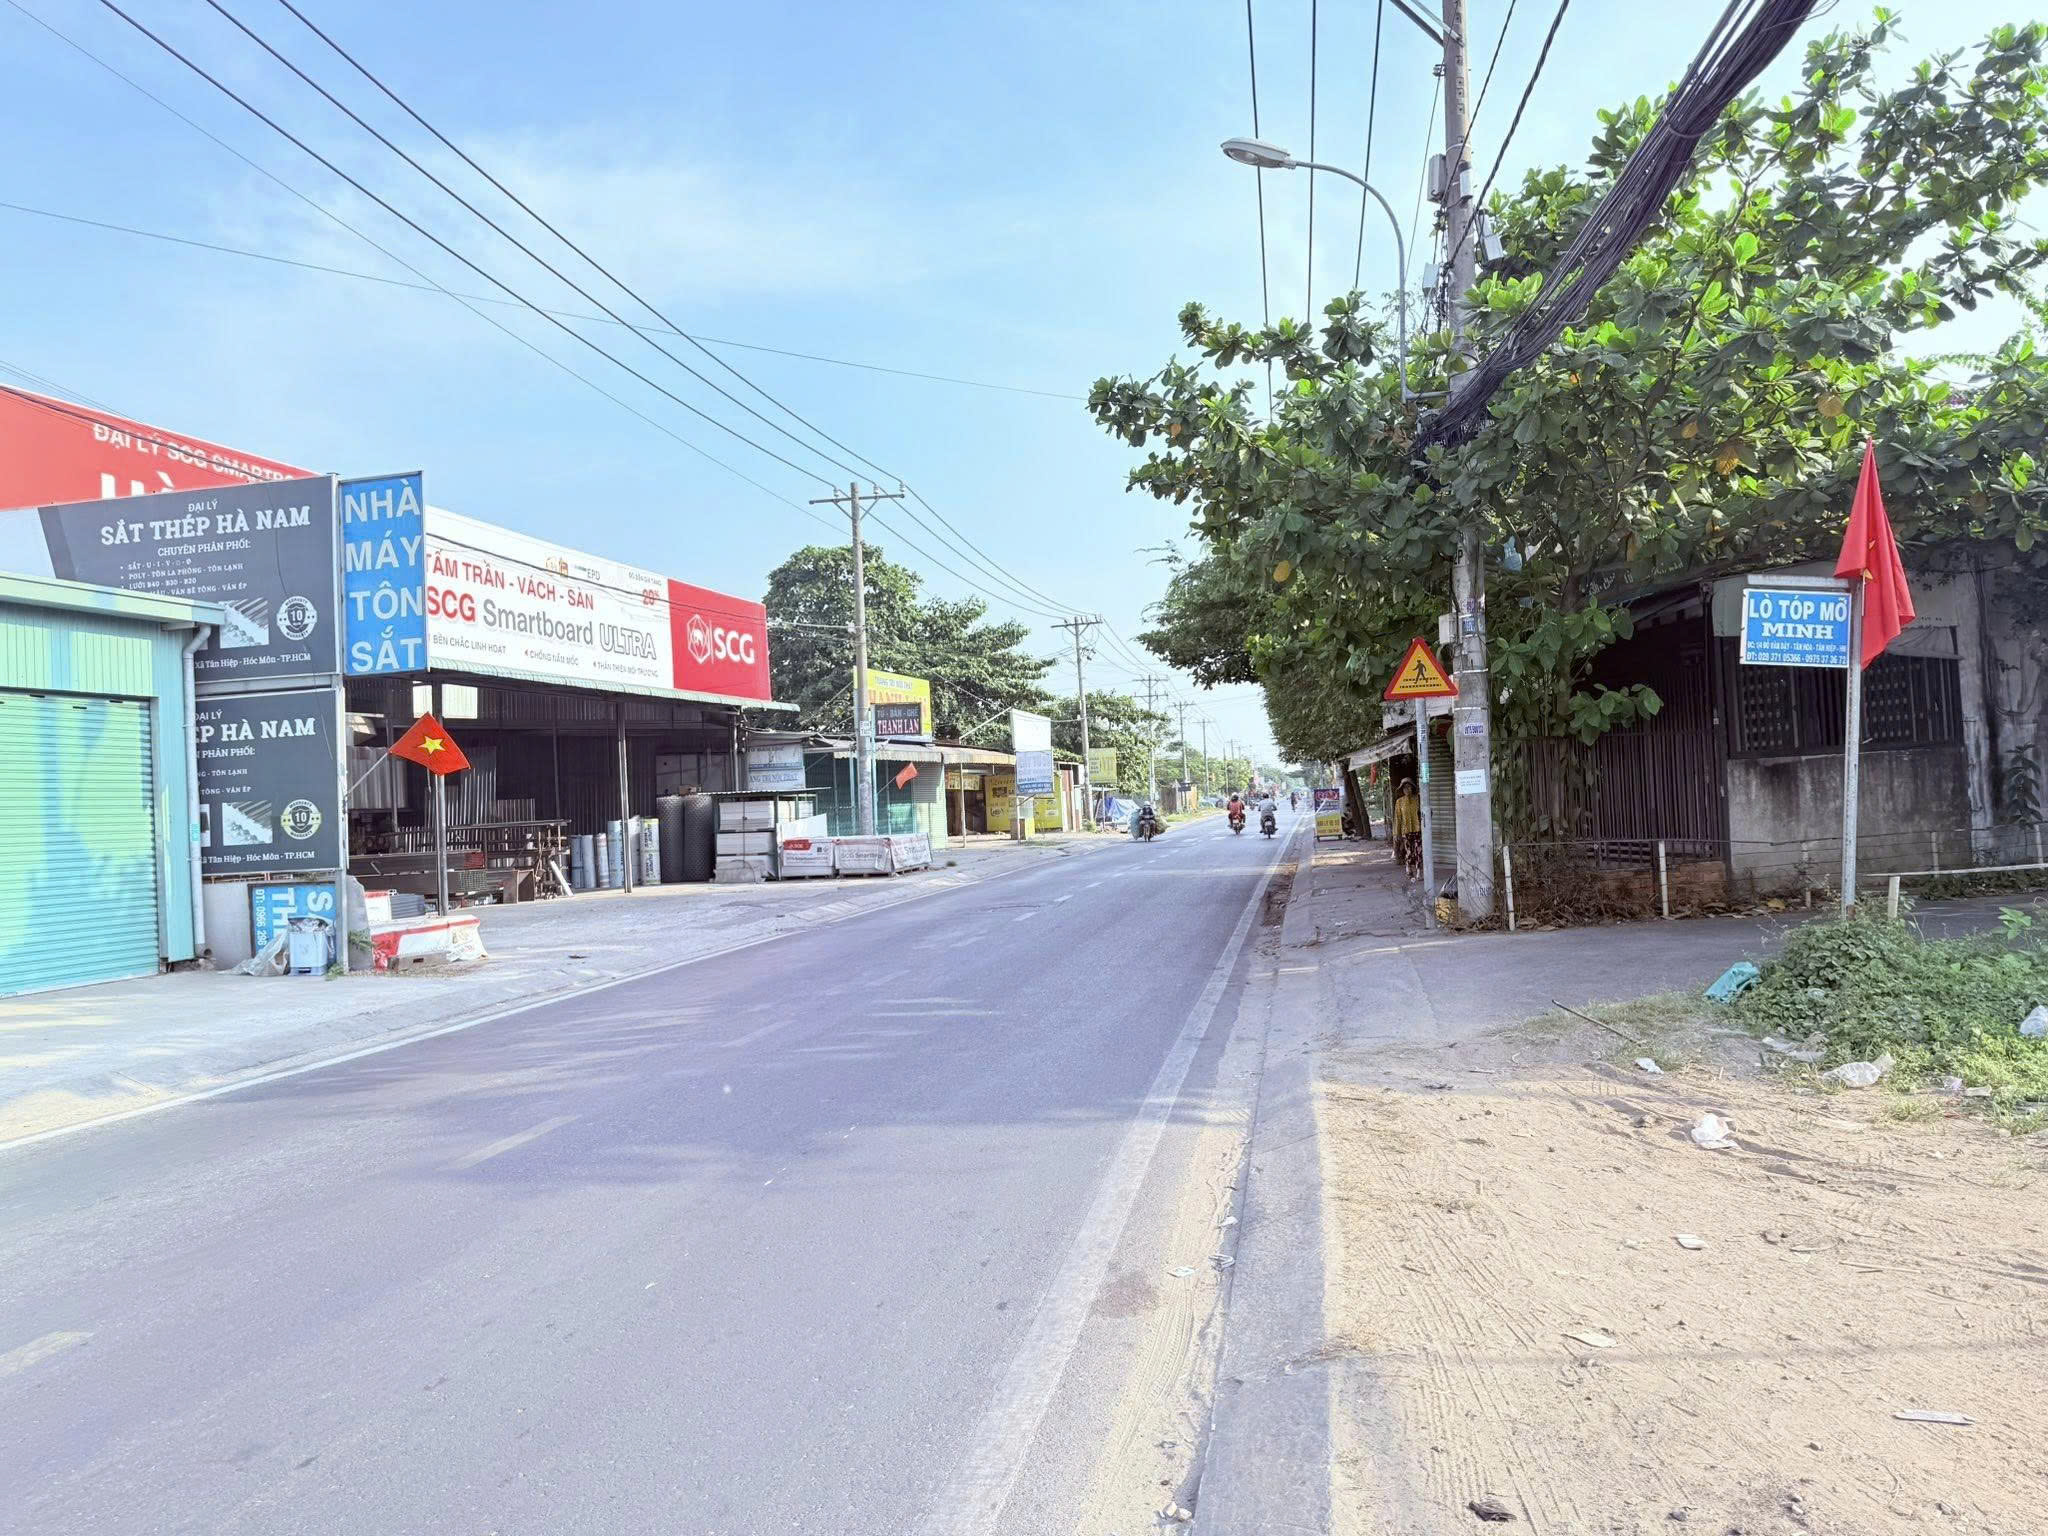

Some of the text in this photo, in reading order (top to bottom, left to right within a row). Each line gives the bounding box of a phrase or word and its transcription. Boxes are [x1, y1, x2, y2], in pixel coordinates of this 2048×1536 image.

[93, 425, 131, 449] ĐẠI
[188, 499, 218, 514] ĐẠI LÝ
[344, 479, 421, 523] NHÀ
[101, 506, 310, 546] SẮT THÉP HÀ NAM
[198, 542, 224, 554] PHÂN
[346, 530, 422, 573] MÁY
[426, 549, 458, 578] TẤM
[462, 560, 505, 590] TRẦN
[517, 575, 556, 602] VÁCH
[568, 587, 594, 610] SÀN
[349, 580, 423, 621] TÔN
[1750, 594, 1773, 618] LÒ
[1778, 595, 1815, 620] TÓP
[290, 610, 303, 622] 10
[427, 586, 658, 660] SCG Smartboard ULTRA
[1762, 622, 1834, 639] MINH
[352, 625, 422, 672] SẮT
[472, 639, 487, 650] LINH
[713, 627, 756, 664] SCG
[280, 653, 312, 662] TP.HCM
[211, 710, 222, 720] LÝ
[220, 719, 254, 742] HÀ
[260, 718, 316, 738] NAM
[878, 719, 903, 734] THANH
[904, 718, 919, 734] LAN
[202, 748, 228, 758] PHÂN
[294, 812, 307, 822] 10
[284, 850, 316, 860] TP.HCM
